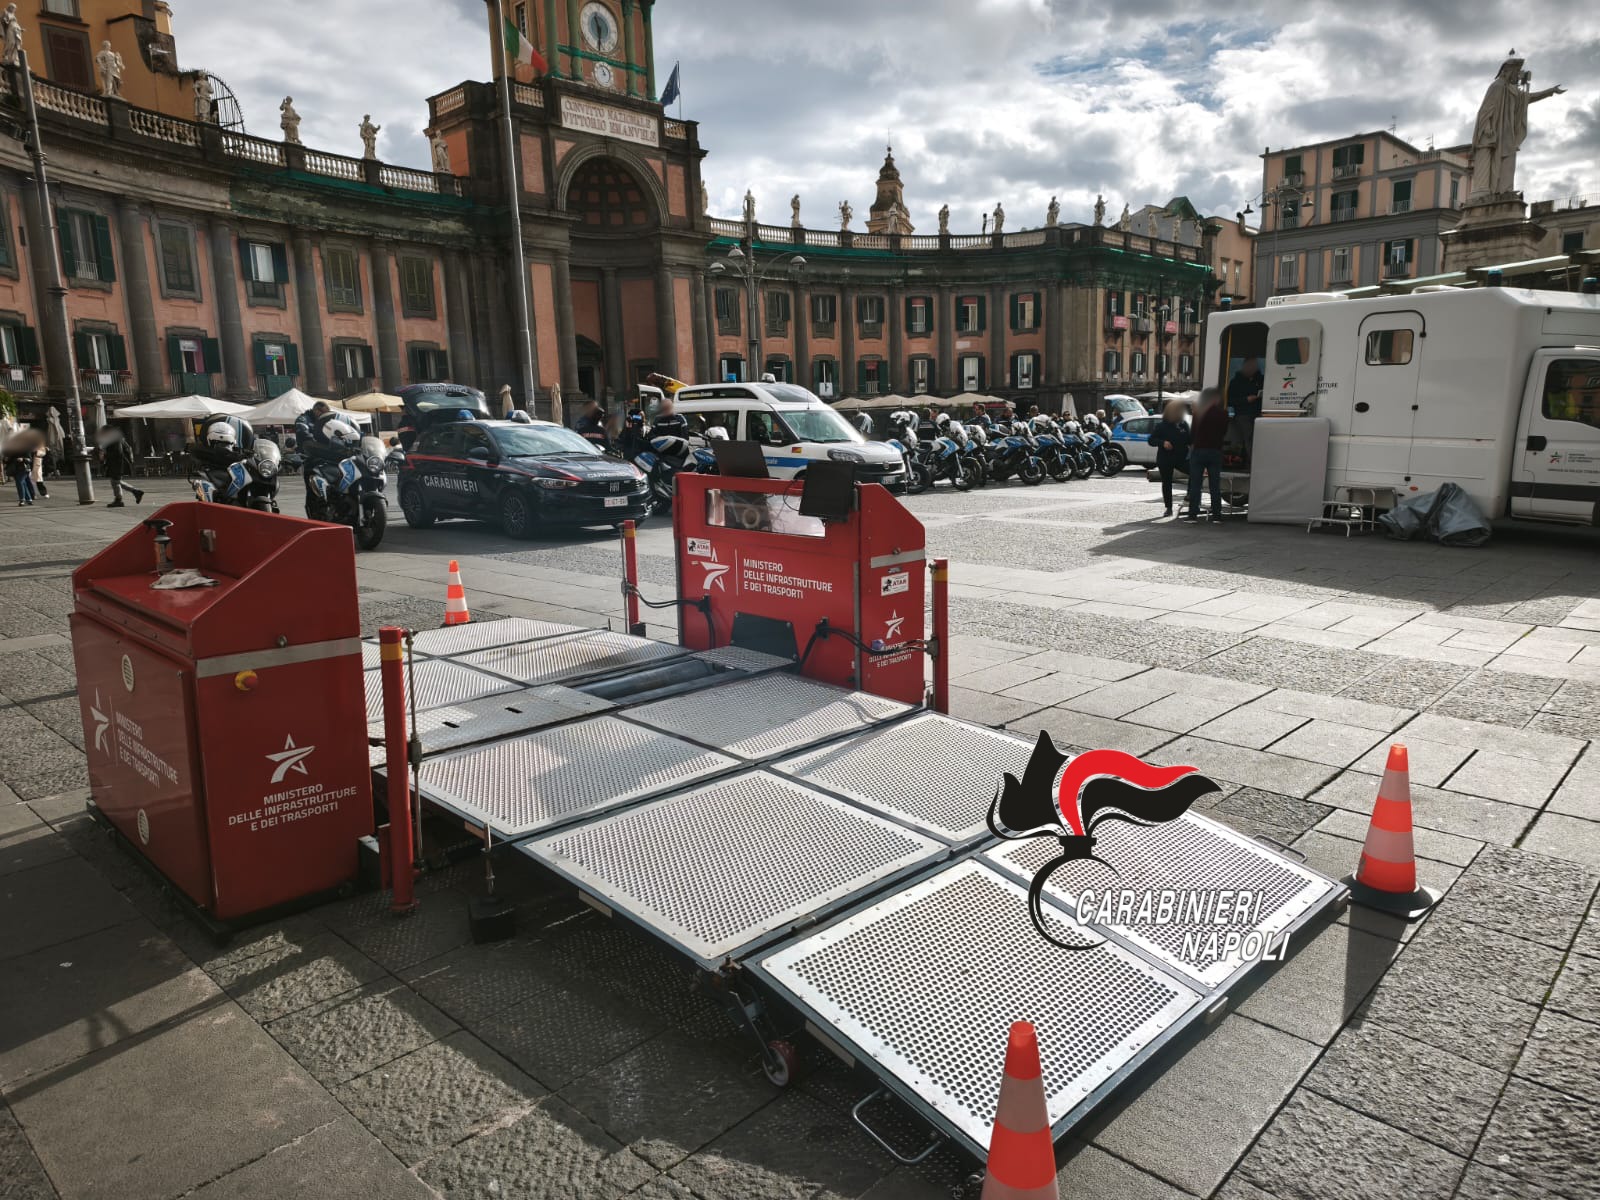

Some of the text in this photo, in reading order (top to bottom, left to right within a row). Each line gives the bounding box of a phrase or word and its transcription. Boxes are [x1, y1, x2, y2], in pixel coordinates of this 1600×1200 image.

[562, 111, 607, 131] VITTORIO
[564, 100, 651, 129] CONVITTO NAZIONALE
[424, 475, 479, 493] CARABINIERI
[743, 558, 783, 573] MINISTERO
[743, 569, 833, 592] DELLE INFRASTRUTTURE
[743, 581, 804, 599] E DEI TRASPORTI
[115, 711, 142, 740] MINISTERO
[132, 739, 178, 785] INFRASTRUTTURE
[263, 783, 323, 805] MINISTERO
[228, 786, 357, 826] DELLE INFRASTRUTTURE
[250, 801, 339, 831] E DEI TRASPORTI
